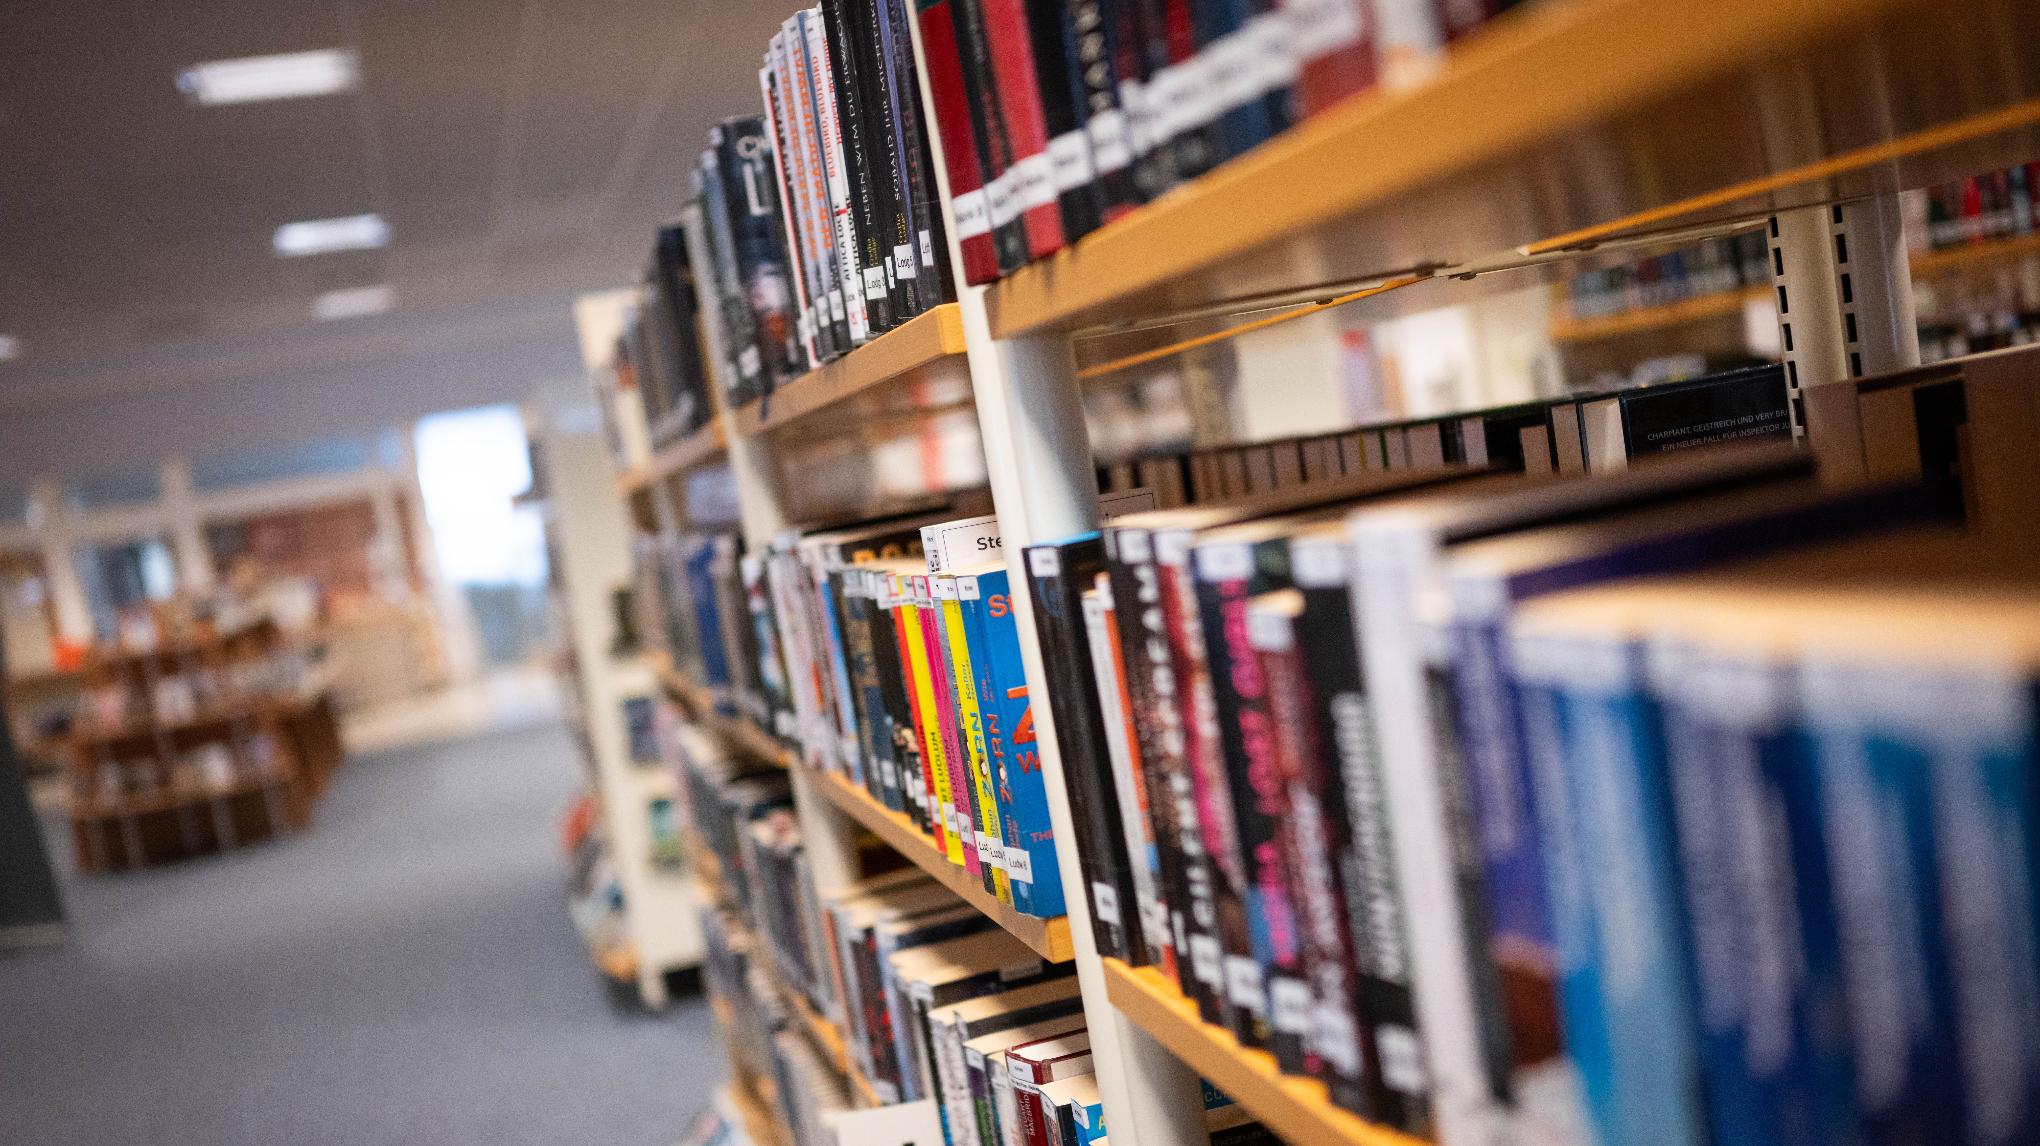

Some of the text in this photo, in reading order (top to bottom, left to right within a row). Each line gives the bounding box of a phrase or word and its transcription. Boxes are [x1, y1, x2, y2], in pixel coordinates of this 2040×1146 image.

[812, 56, 826, 115] BLUEBIRD
[847, 92, 856, 117] DU
[851, 124, 863, 166] WEM
[887, 135, 900, 200] SOBALD
[858, 172, 872, 225] NEBEN
[834, 203, 851, 281] ATTICA LOCKE
[1693, 418, 1736, 433] GEISTREICH
[1737, 415, 1754, 425] UND
[1755, 411, 1774, 421] VERY
[1775, 408, 1789, 418] BRI
[1739, 424, 1780, 438] INSPEKTOR
[931, 731, 945, 783] LUDLUM
